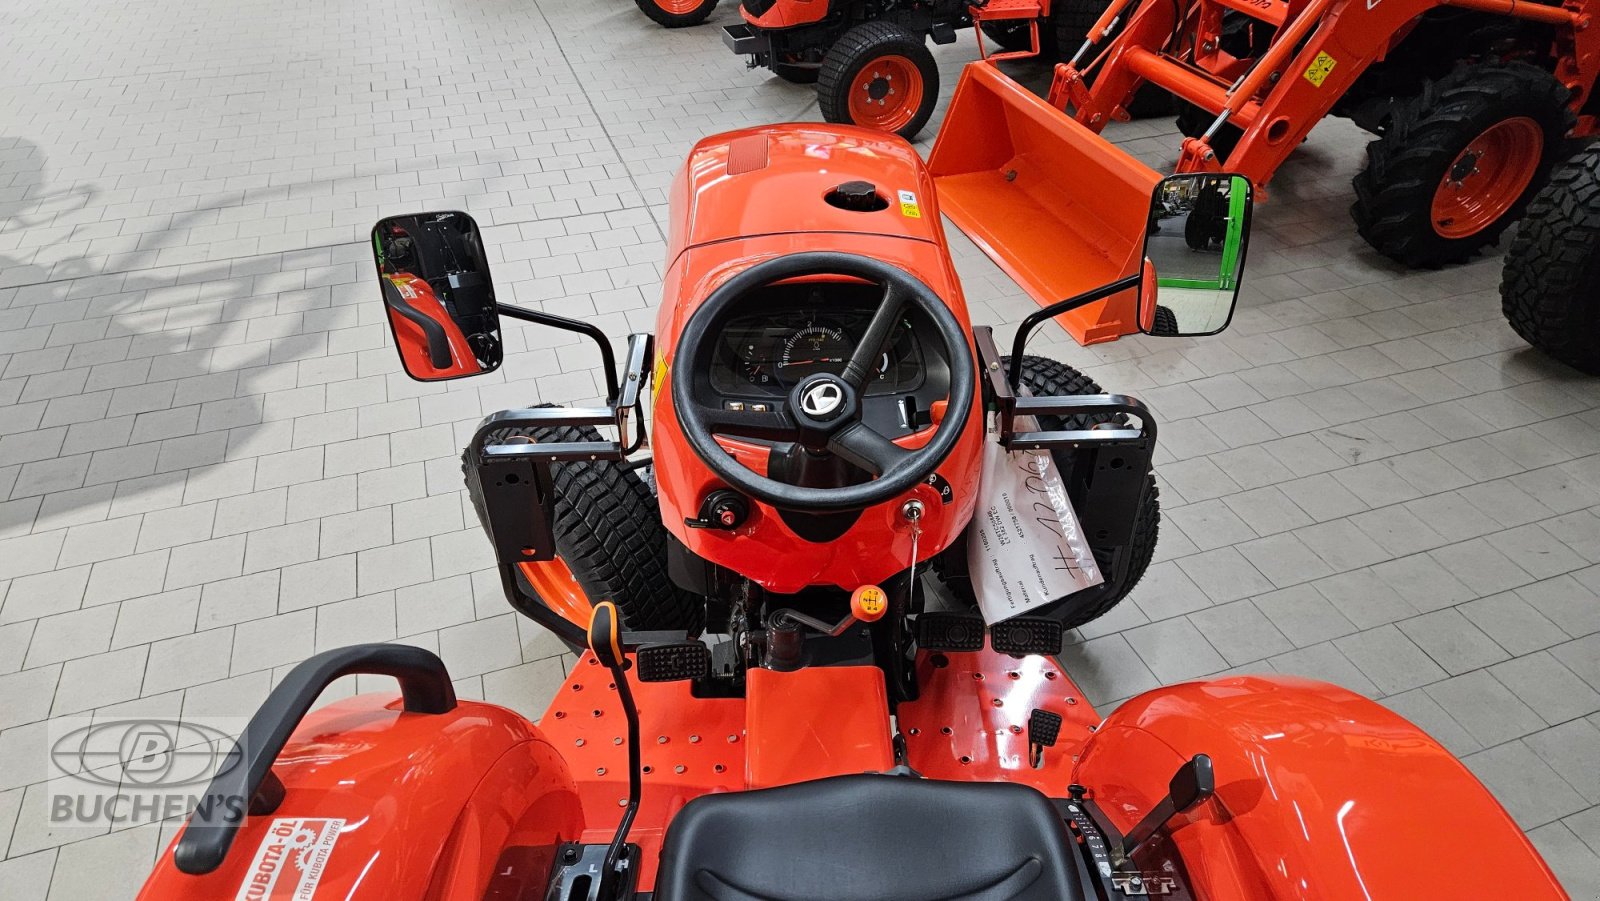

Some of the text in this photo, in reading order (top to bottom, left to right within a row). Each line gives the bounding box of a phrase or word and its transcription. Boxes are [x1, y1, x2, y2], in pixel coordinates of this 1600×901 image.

[1029, 553, 1050, 597] Kundenauftrag
[1017, 580, 1031, 604] Material
[300, 820, 342, 900] FÜR KUBOTA POWER
[588, 863, 598, 873] L
[618, 859, 629, 869] H
